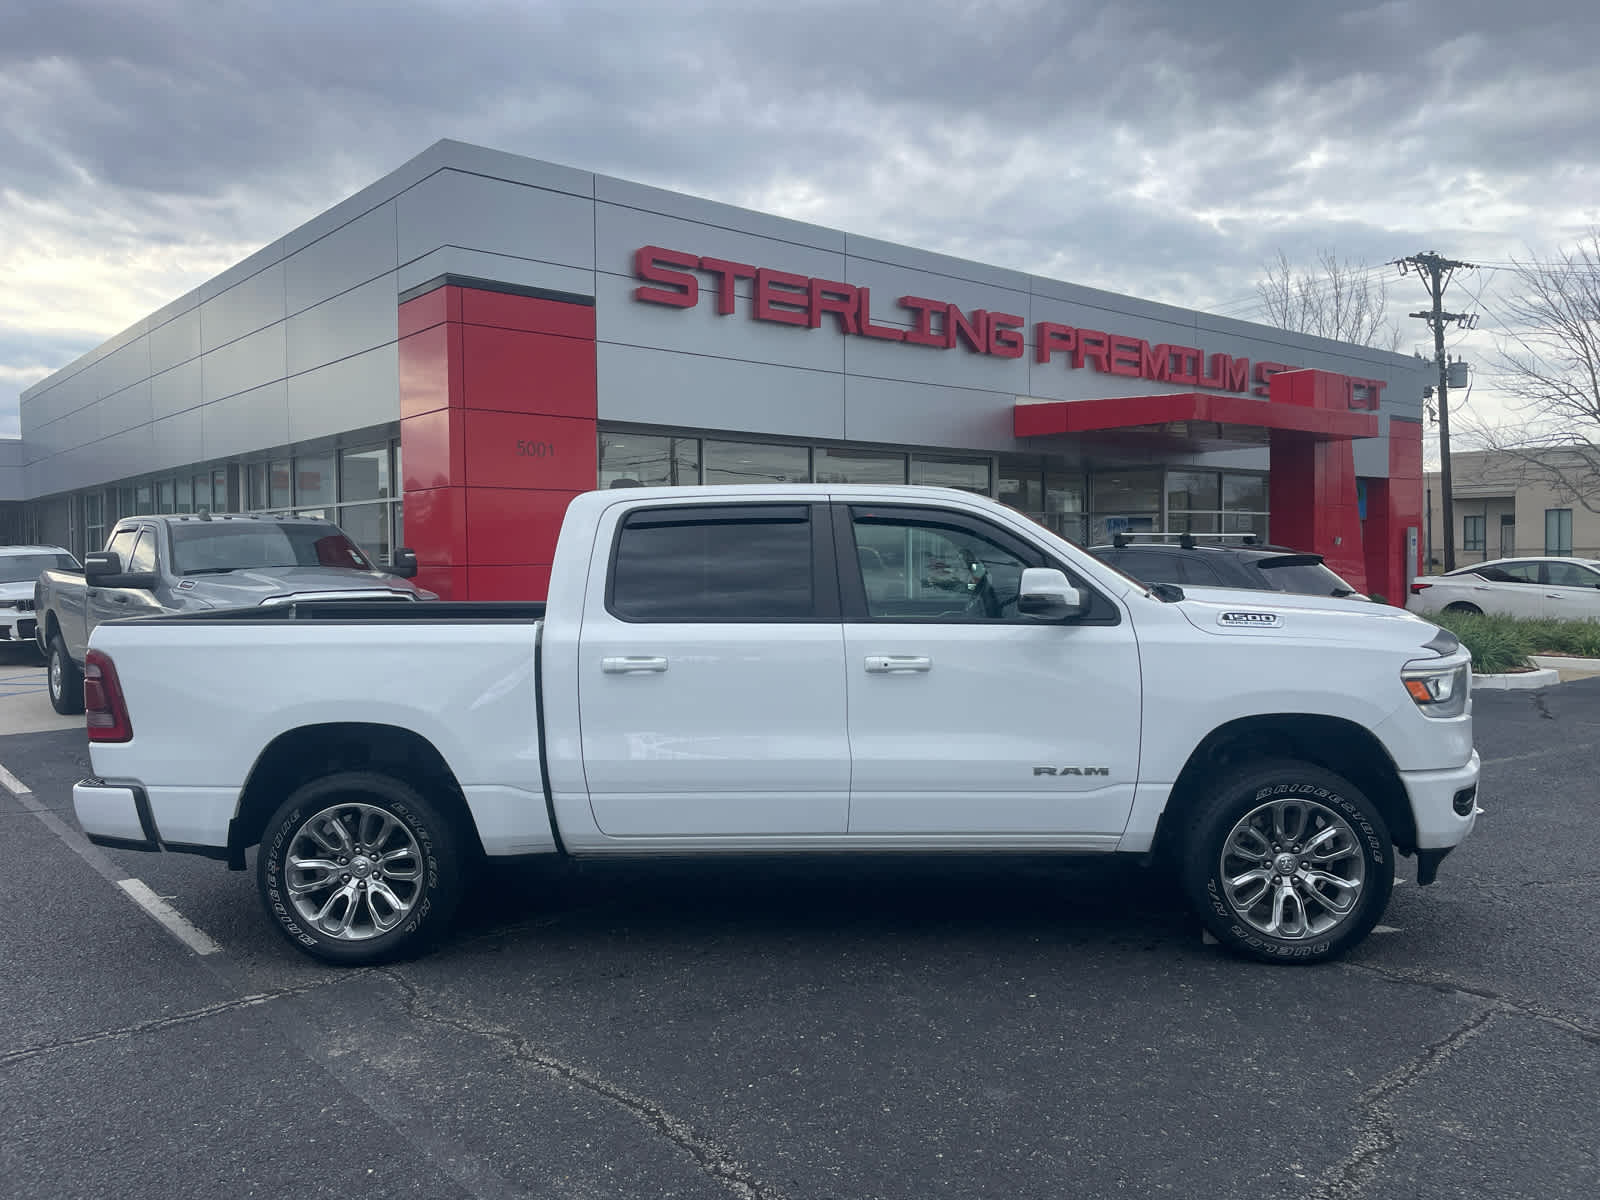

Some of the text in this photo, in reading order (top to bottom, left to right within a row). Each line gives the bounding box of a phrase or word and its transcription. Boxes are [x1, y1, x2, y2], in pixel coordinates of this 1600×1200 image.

[635, 245, 1387, 411] STERLING PREMIUM SCT
[515, 439, 555, 457] 5001
[1226, 613, 1276, 622] 1500
[1033, 767, 1109, 776] RAM
[1256, 784, 1384, 864] BRIDGESTONE
[267, 808, 318, 946] BRIDGESTONE
